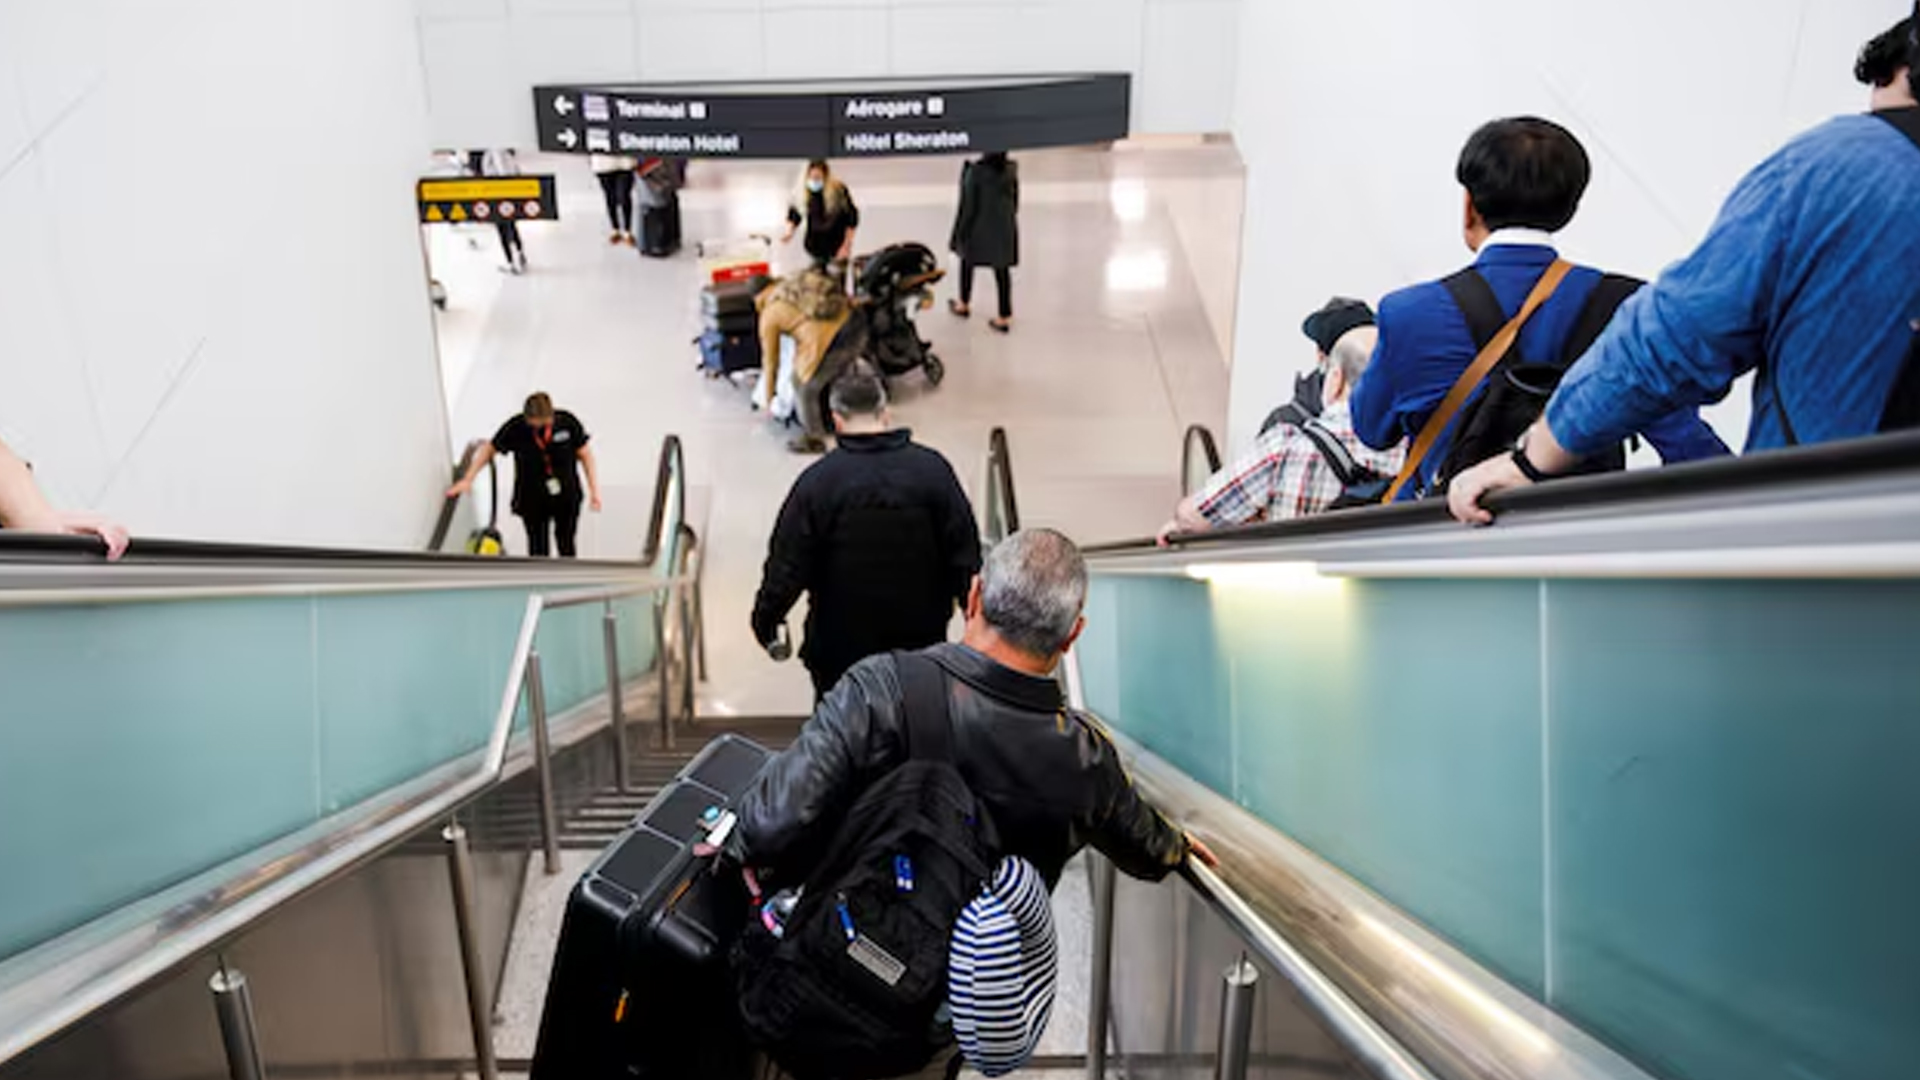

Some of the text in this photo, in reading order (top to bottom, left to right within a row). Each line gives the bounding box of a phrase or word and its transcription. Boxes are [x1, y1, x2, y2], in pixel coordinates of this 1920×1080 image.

[616, 101, 685, 118] Terminal
[846, 100, 922, 118] Aérogare
[619, 132, 739, 150] Sheraton Hotel
[894, 131, 969, 149] Sheraton
